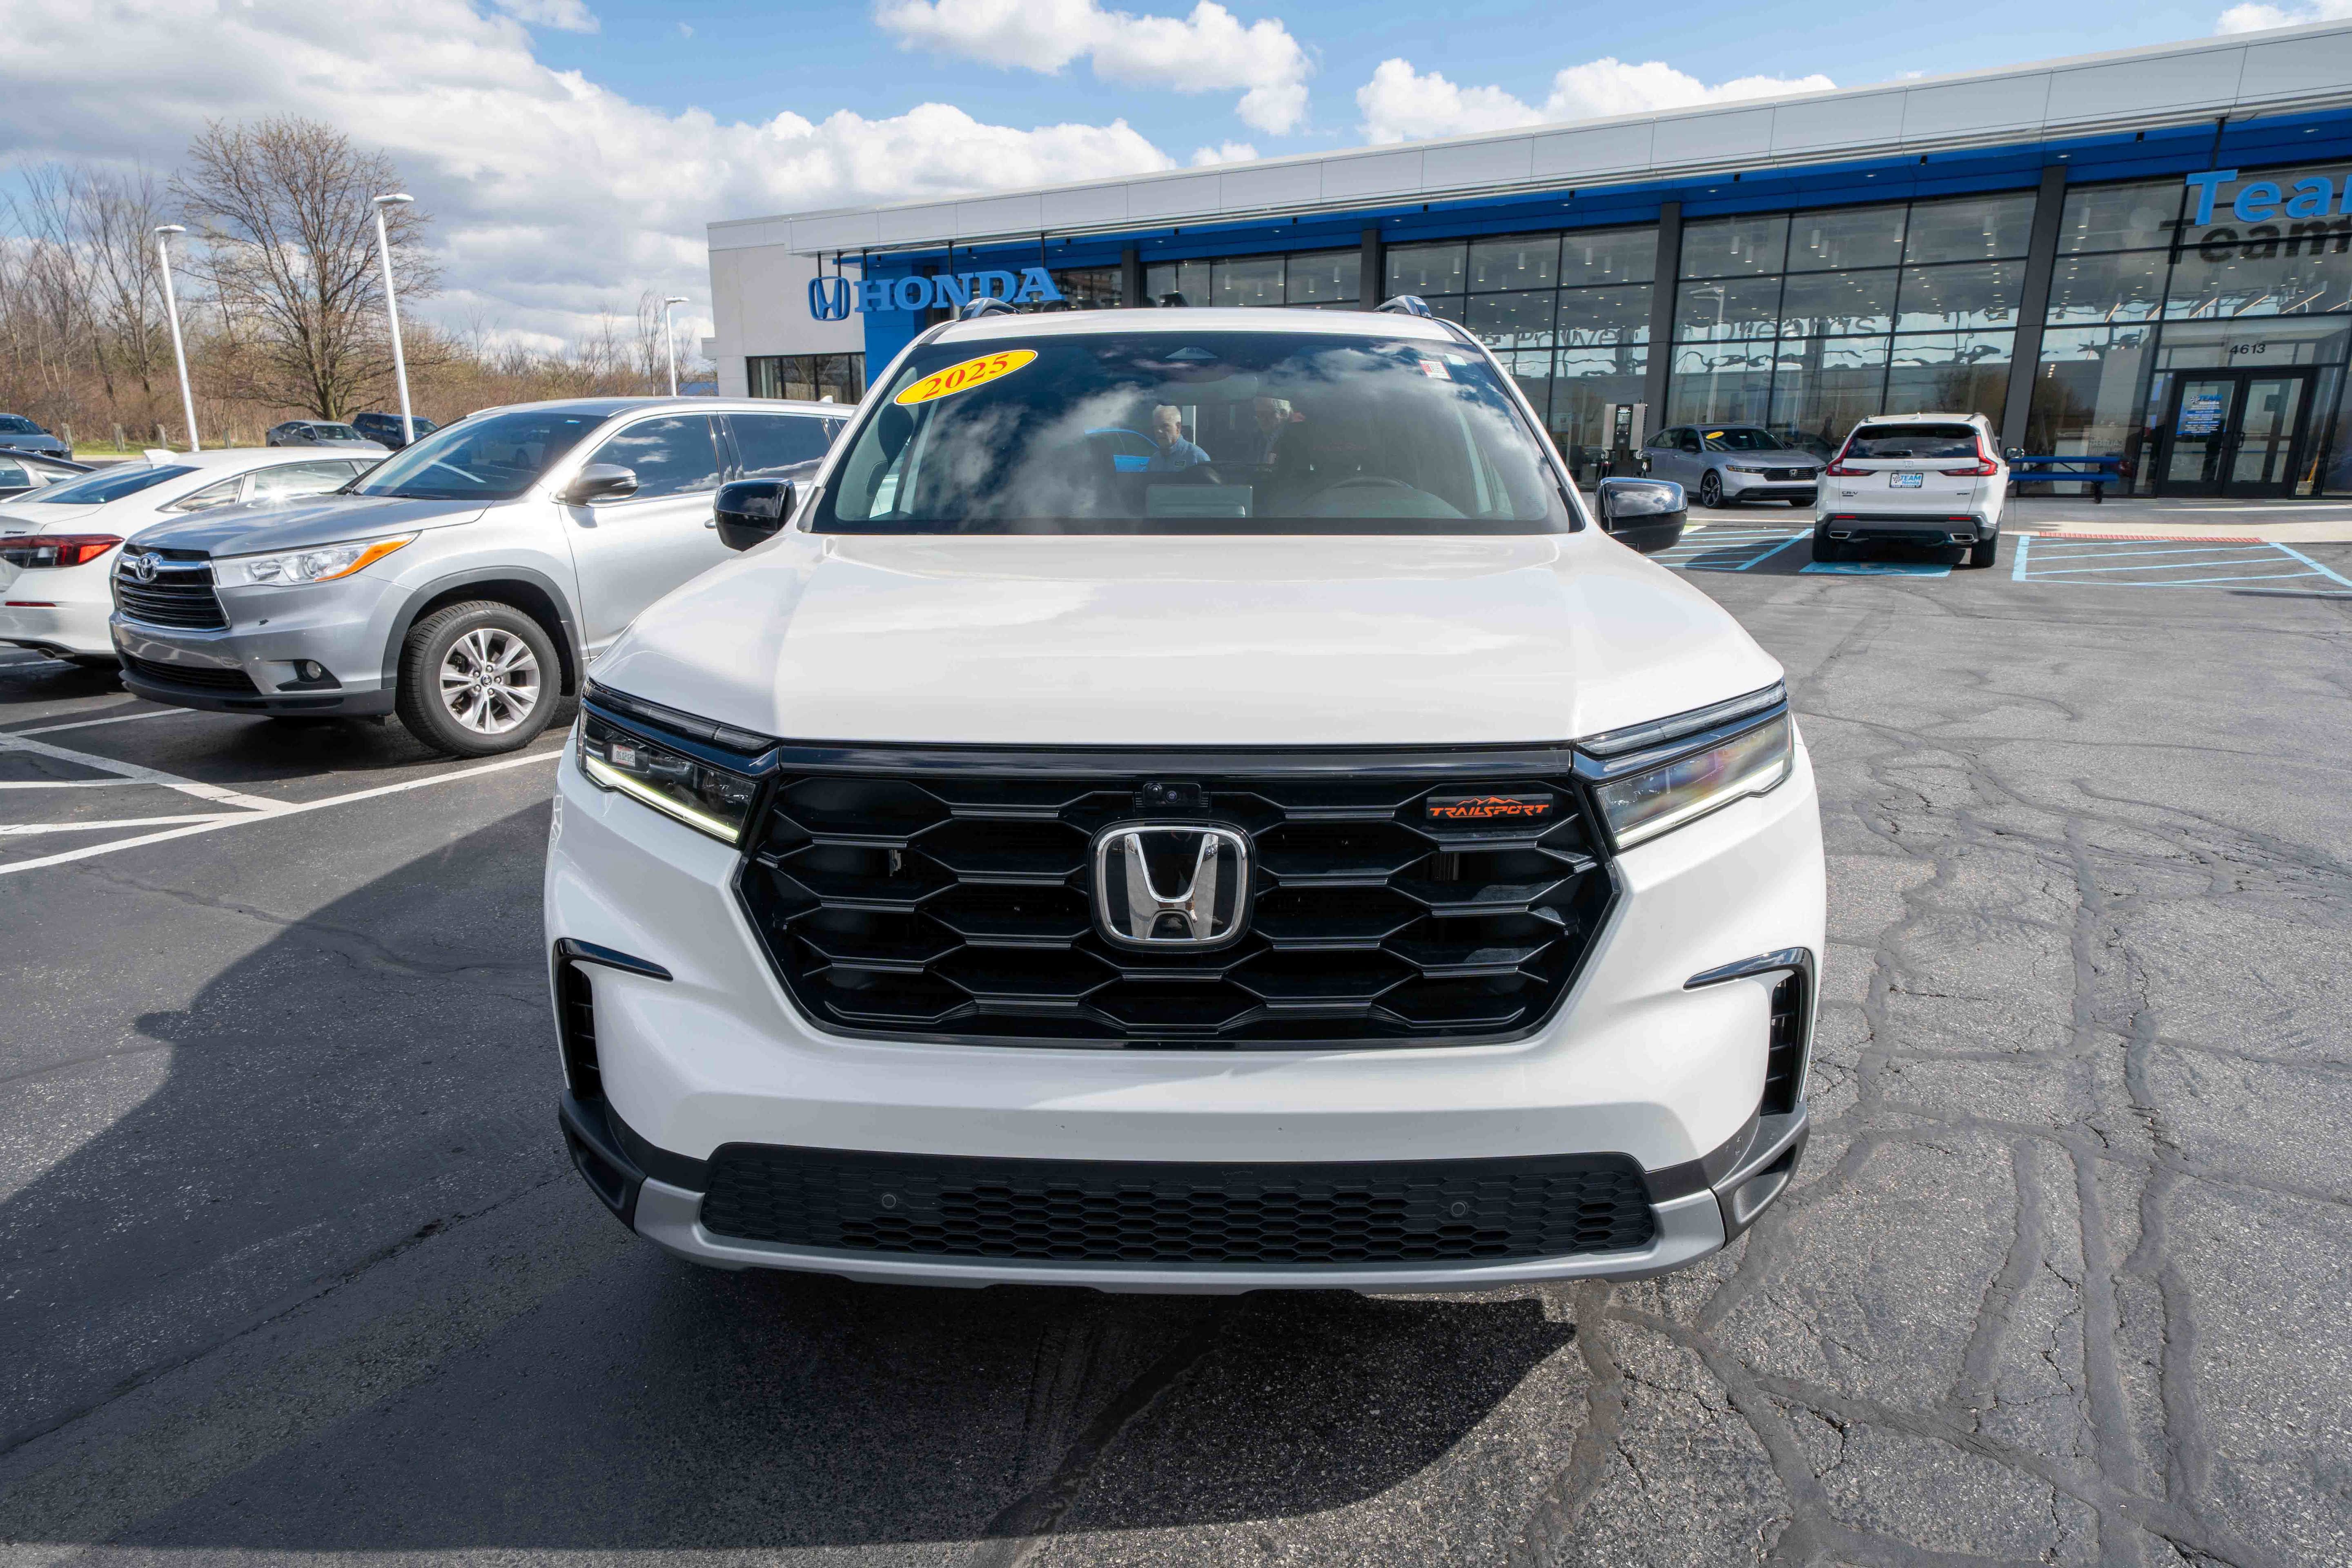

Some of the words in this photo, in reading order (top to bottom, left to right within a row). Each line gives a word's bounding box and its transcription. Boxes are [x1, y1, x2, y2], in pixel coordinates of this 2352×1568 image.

[2186, 169, 2352, 225] Tea
[853, 267, 1065, 312] HONDA
[2230, 343, 2266, 354] 4613
[921, 354, 1009, 399] 2025
[1429, 804, 1550, 818] TRAILSPORT
